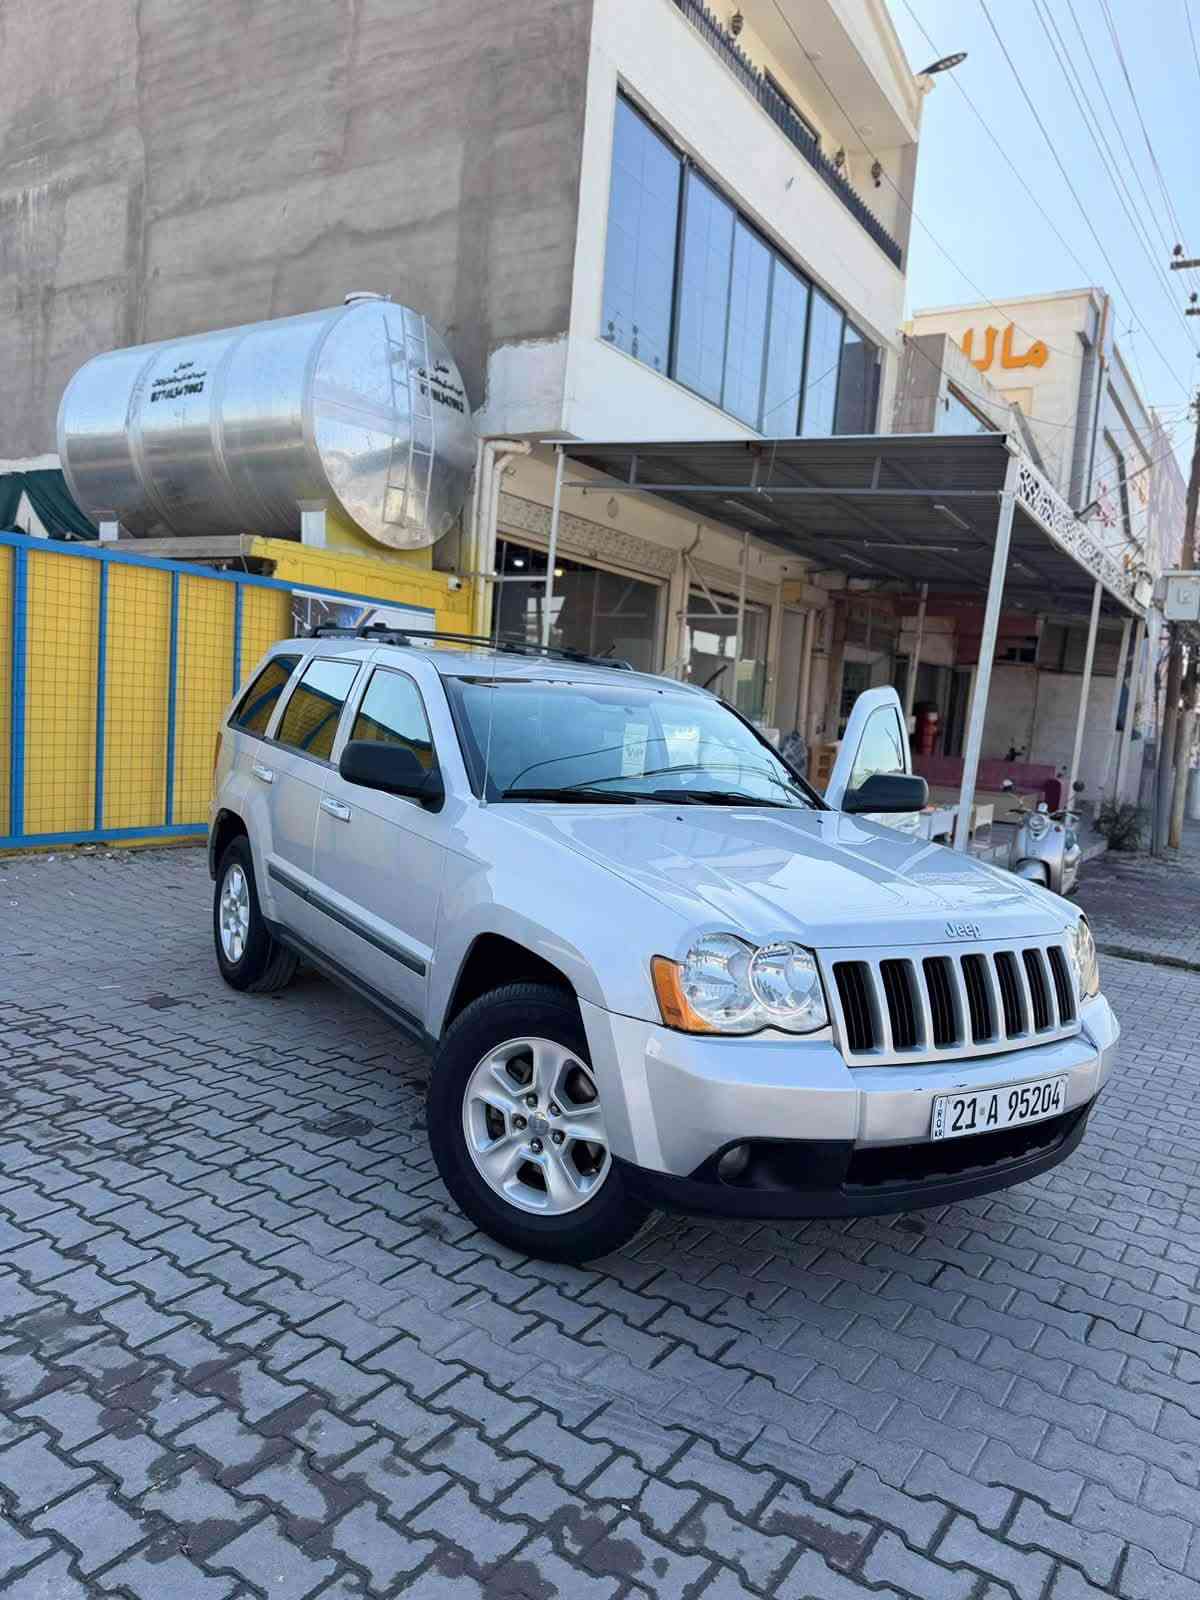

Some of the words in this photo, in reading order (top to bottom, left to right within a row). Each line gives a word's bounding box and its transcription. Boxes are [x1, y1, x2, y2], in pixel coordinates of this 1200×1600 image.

[944, 921, 984, 938] Jeep
[951, 1097, 977, 1132] 21
[986, 1094, 999, 1126] A
[1007, 1080, 1061, 1122] 95204
